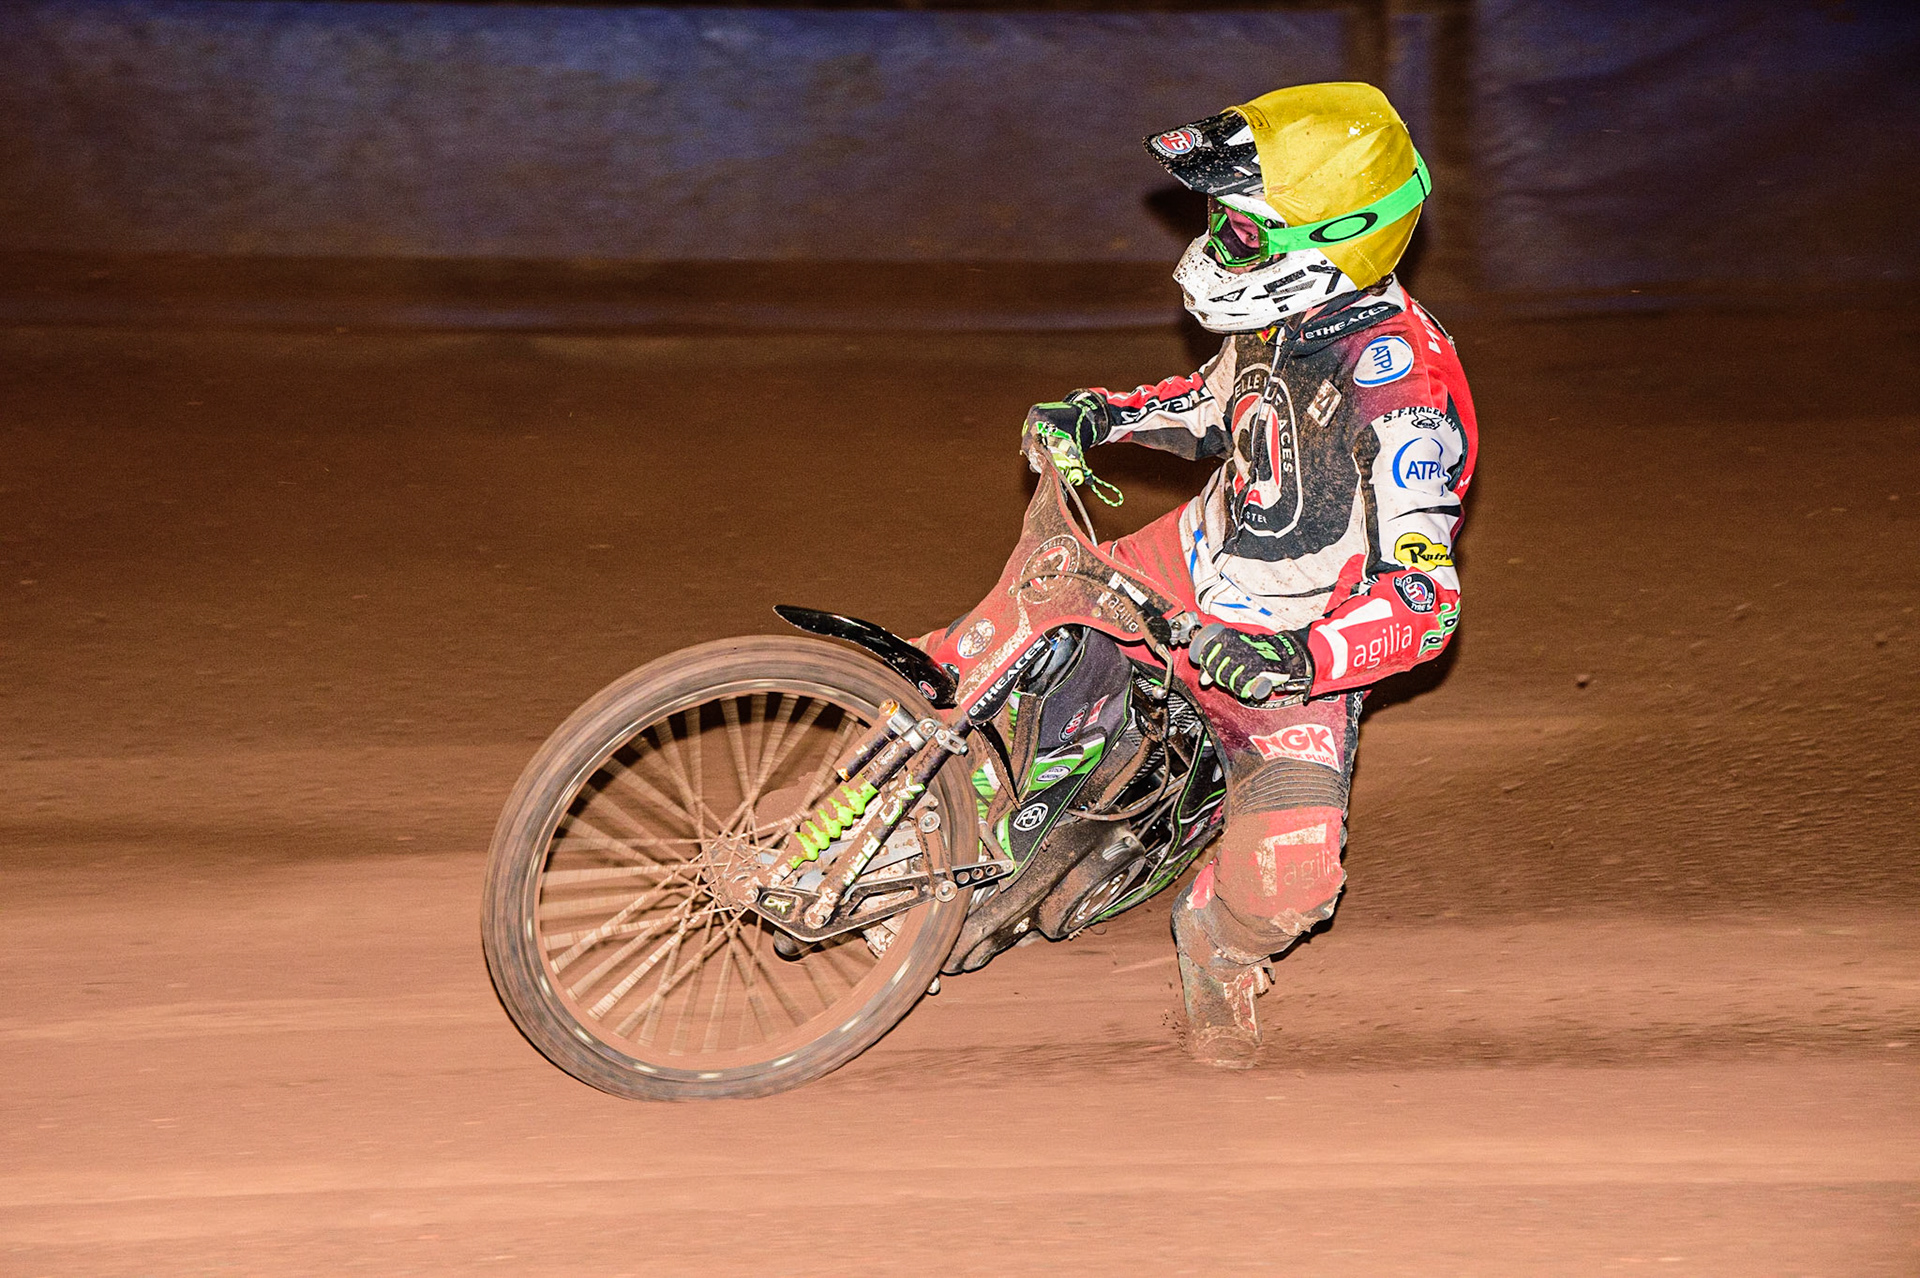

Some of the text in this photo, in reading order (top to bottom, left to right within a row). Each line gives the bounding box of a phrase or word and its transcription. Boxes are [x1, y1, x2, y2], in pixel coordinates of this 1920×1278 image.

[1370, 344, 1394, 375] ATPI
[1234, 374, 1260, 398] ELLE
[1277, 419, 1294, 474] ACES
[1353, 623, 1413, 669] agilia
[1252, 727, 1335, 757] NGK
